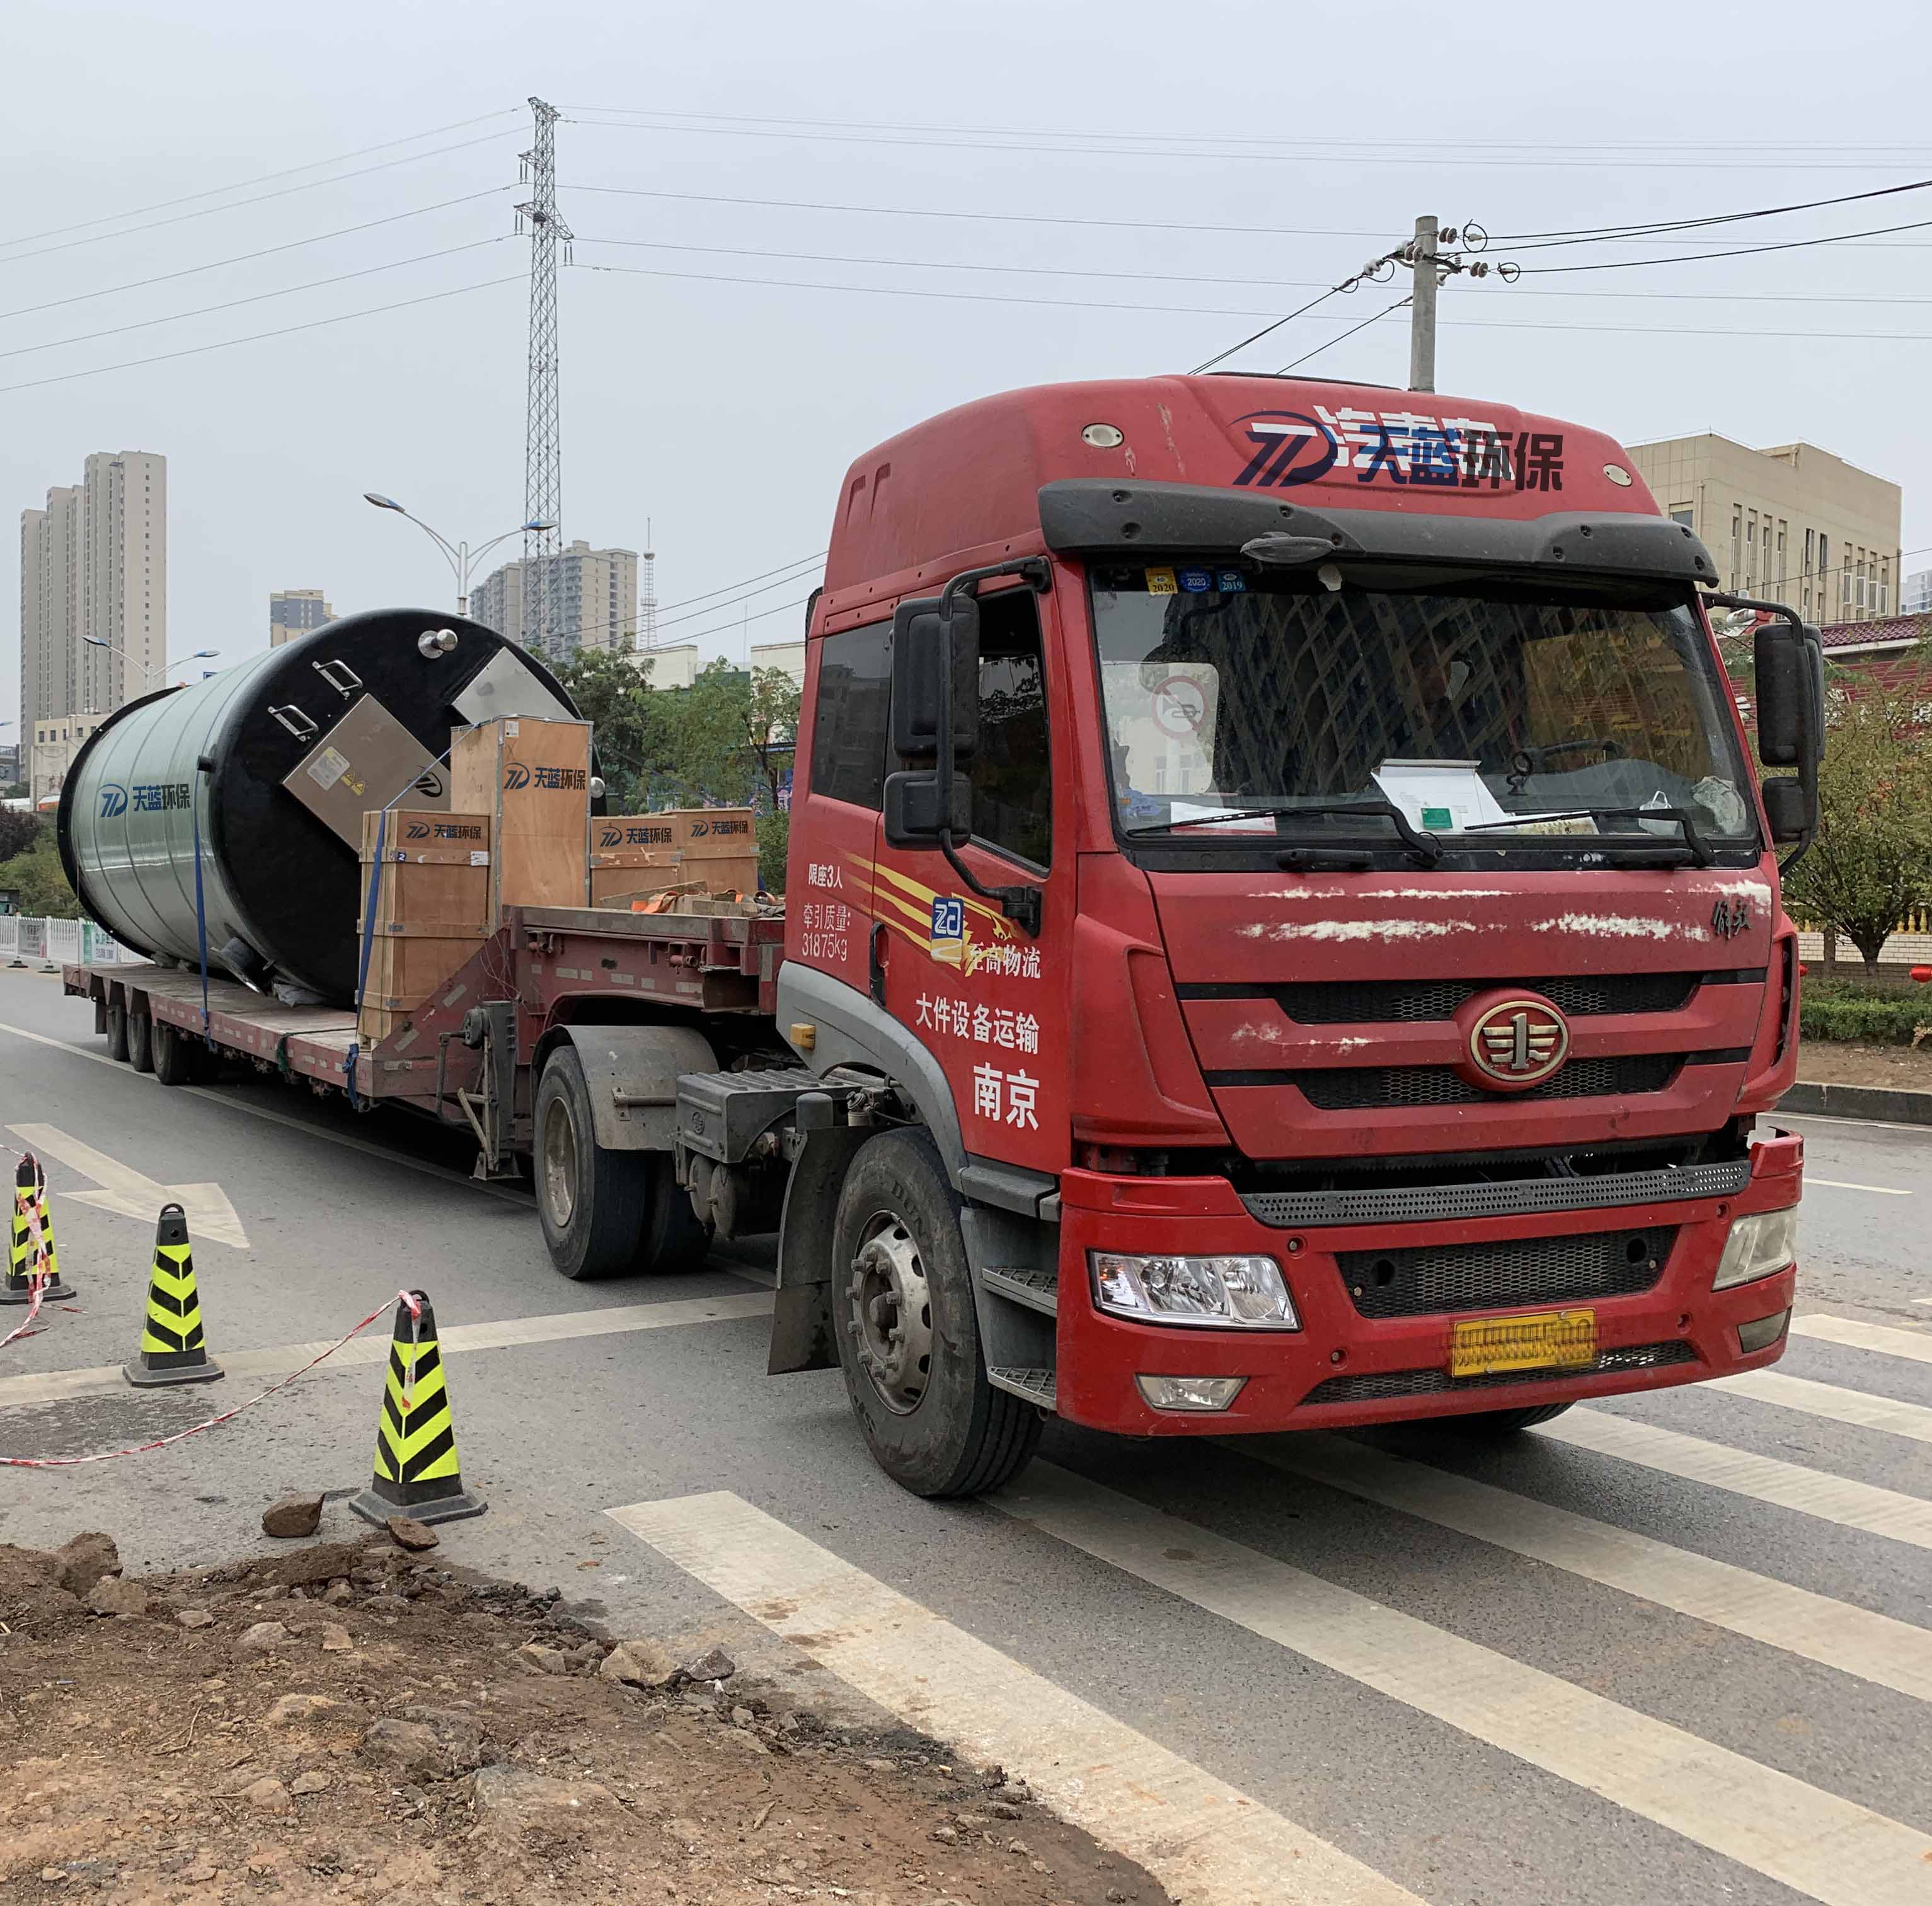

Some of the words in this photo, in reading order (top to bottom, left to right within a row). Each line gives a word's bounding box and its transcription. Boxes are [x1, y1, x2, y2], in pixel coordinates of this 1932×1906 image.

[1357, 424, 1563, 492] 天蓝环保
[1153, 584, 1175, 592] 2020
[1187, 577, 1206, 586] 2020
[1222, 581, 1243, 590] 2019
[534, 767, 586, 790] 天蓝环保
[132, 783, 191, 811] 天蓝环保
[434, 824, 482, 840] 天蓝环保
[626, 827, 672, 844] 天蓝环保
[711, 821, 749, 835] 天蓝环保
[808, 863, 843, 889] 限座3人
[802, 932, 848, 962] 31875kg
[916, 992, 1040, 1054] 大件设备运输
[973, 1061, 1039, 1131] 南京
